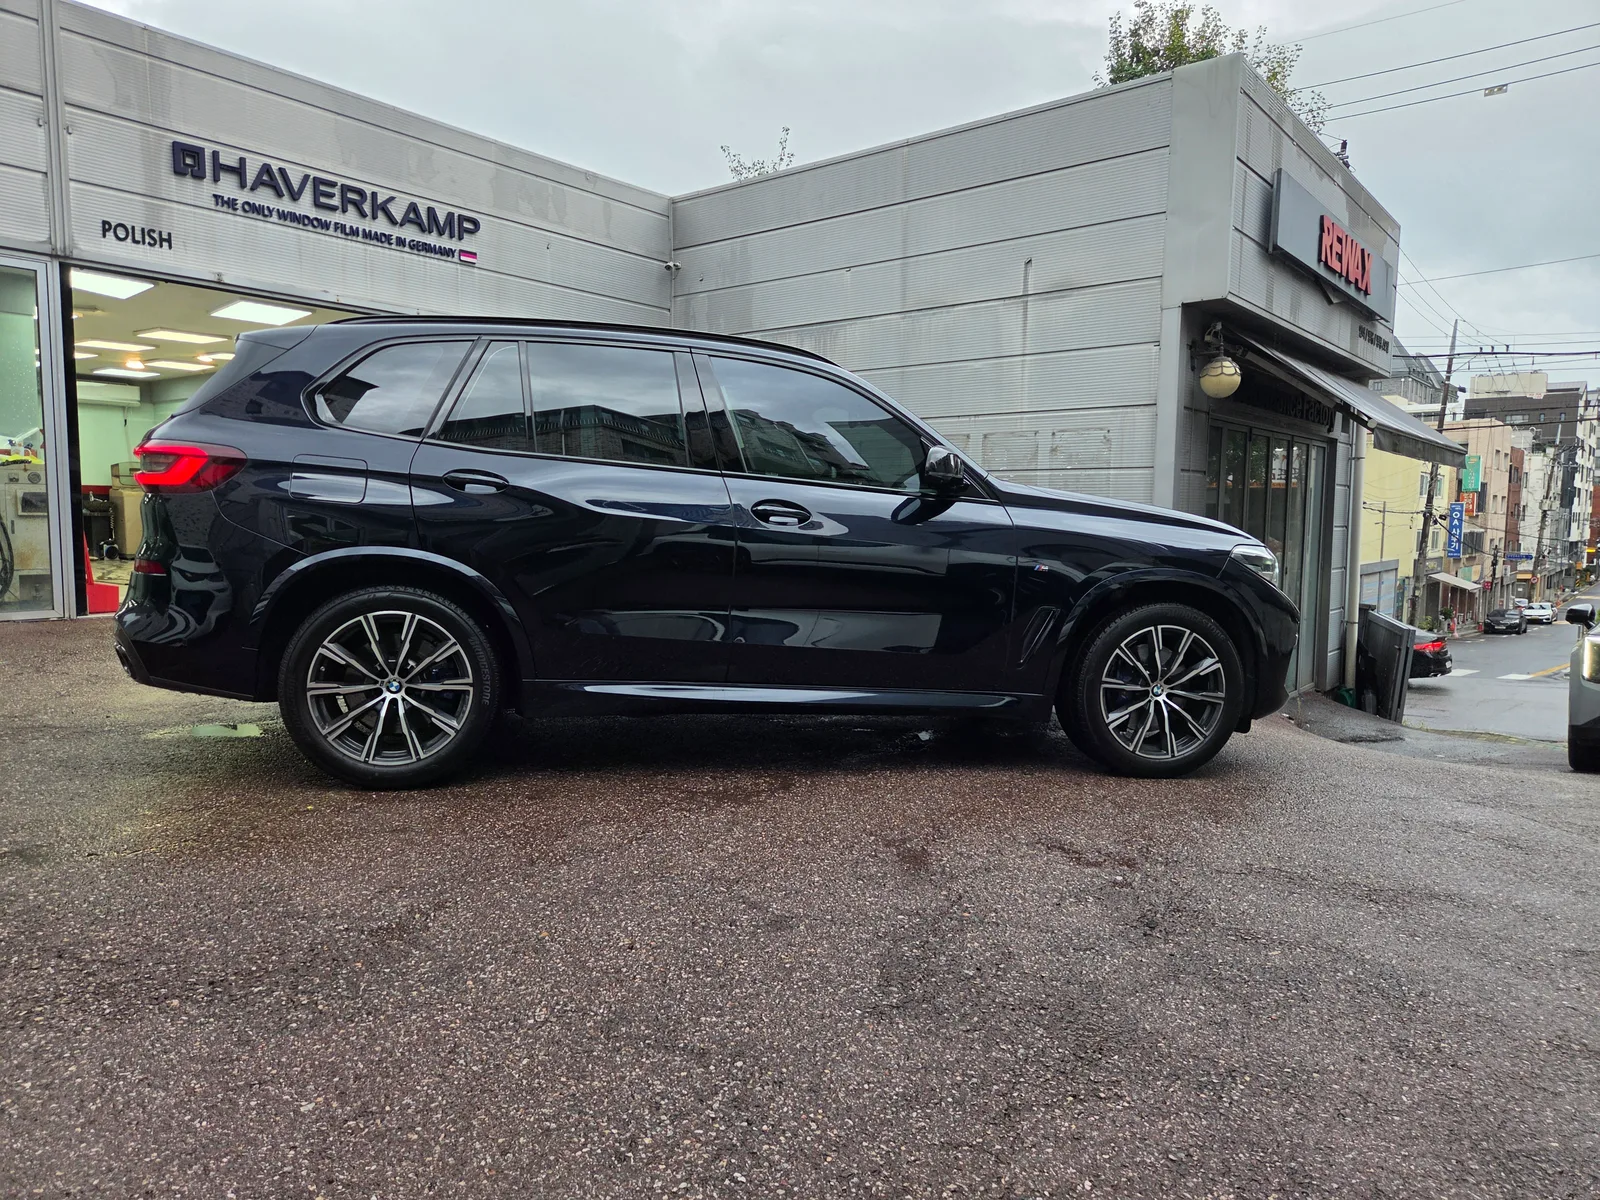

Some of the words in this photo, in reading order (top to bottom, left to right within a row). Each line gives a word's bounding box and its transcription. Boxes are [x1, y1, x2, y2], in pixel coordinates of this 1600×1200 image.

[212, 150, 481, 241] HAVERKAMP
[213, 194, 239, 212] THE
[242, 201, 276, 219] ONLY
[277, 209, 332, 233] WINDOW
[334, 222, 360, 239] FILM
[362, 228, 394, 247] MADE
[396, 236, 407, 248] IN
[408, 239, 457, 259] GERMANY
[101, 219, 173, 250] POLISH
[1319, 214, 1374, 295] REWAX
